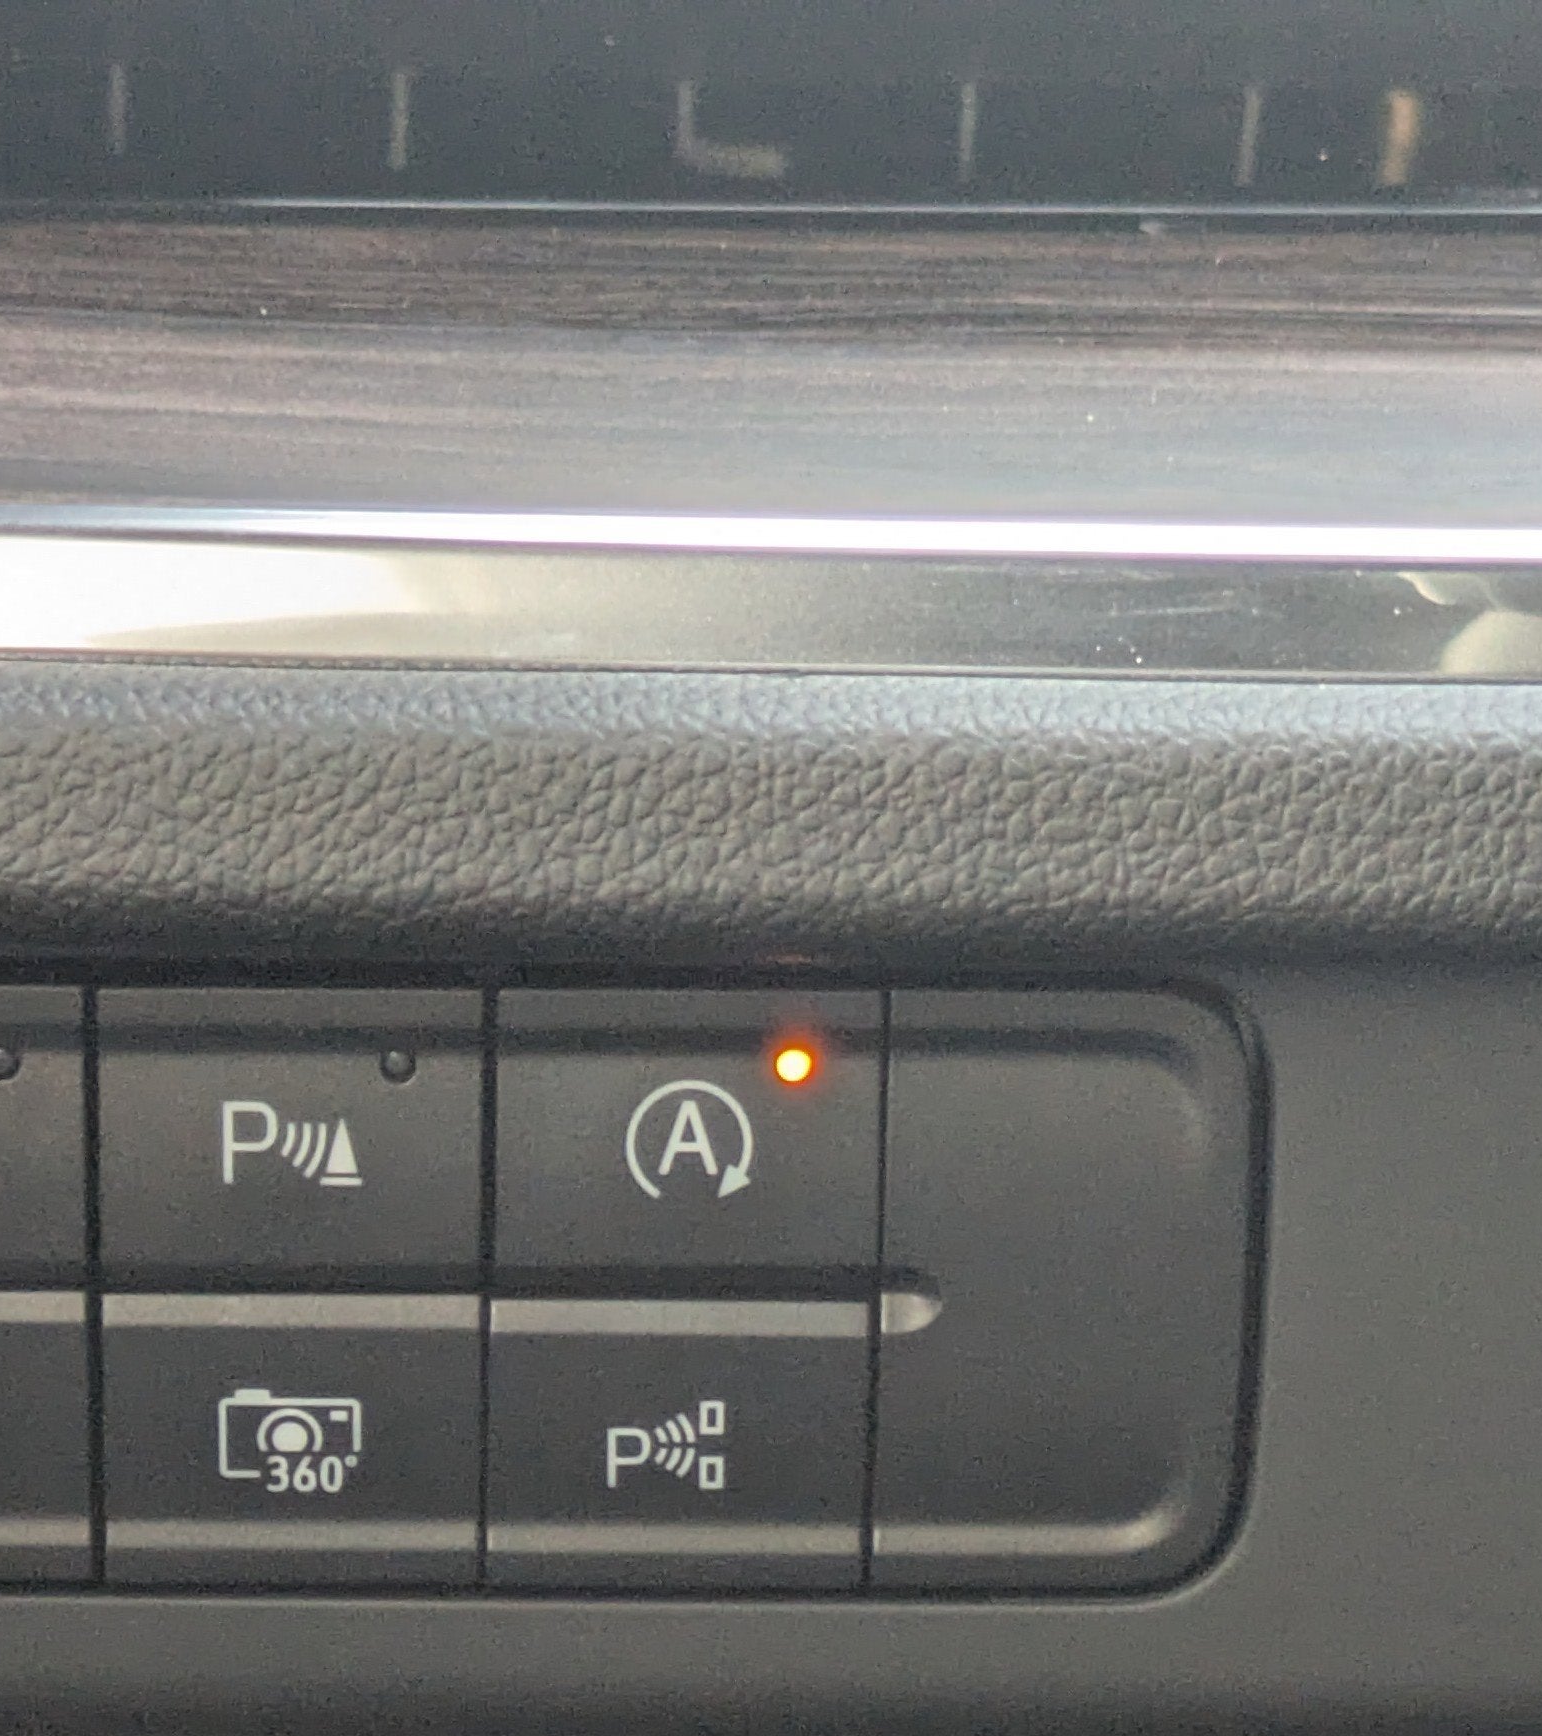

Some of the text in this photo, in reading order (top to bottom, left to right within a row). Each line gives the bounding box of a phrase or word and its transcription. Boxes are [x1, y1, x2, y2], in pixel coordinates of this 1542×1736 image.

[222, 1100, 278, 1184] P
[658, 1099, 719, 1176] A
[606, 1427, 652, 1489] P
